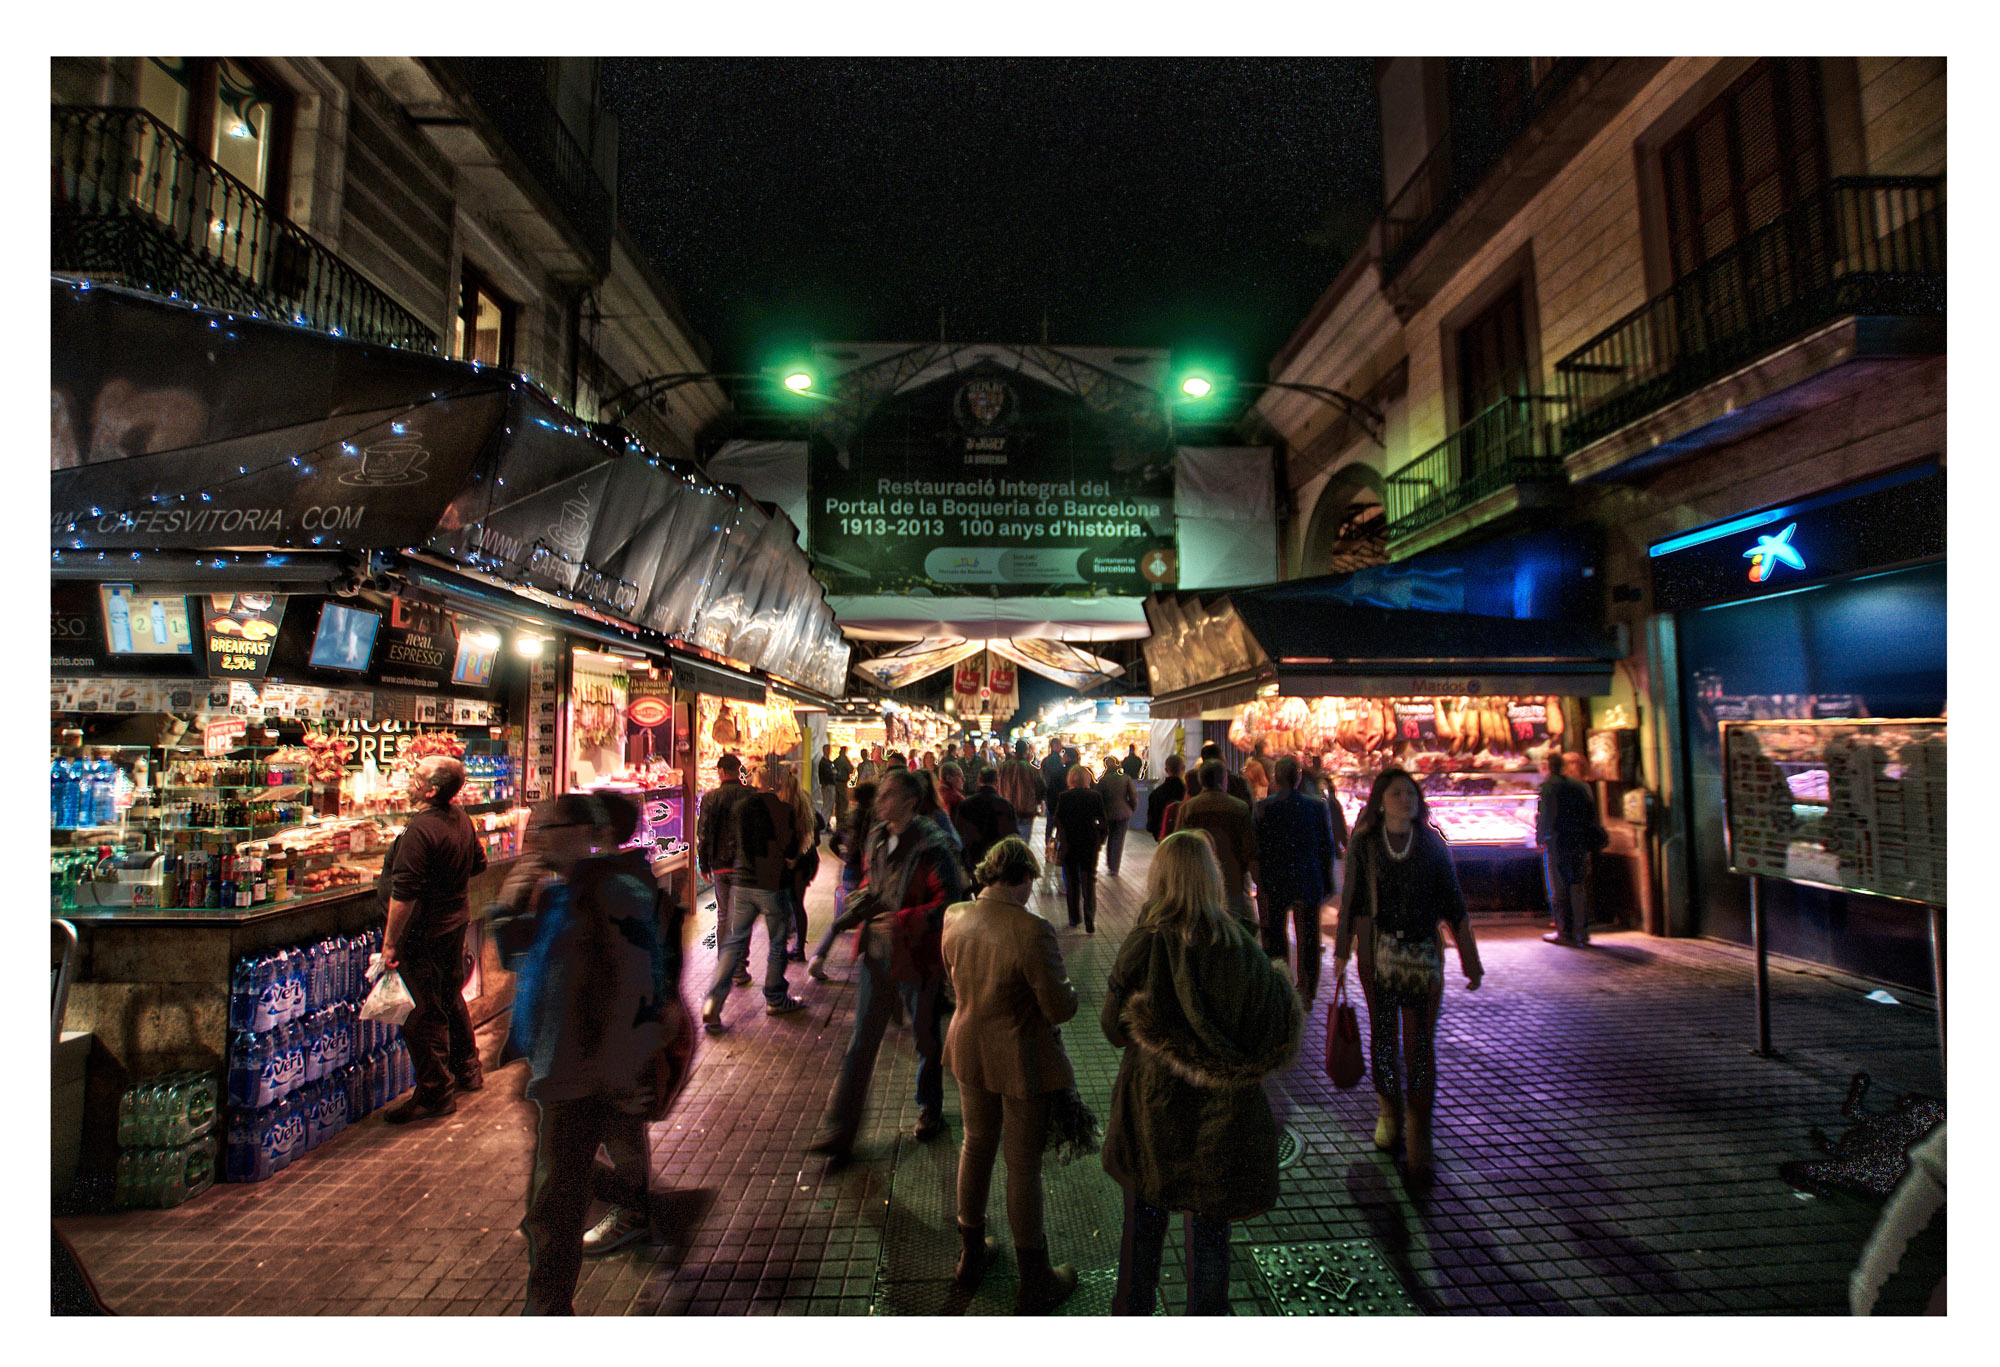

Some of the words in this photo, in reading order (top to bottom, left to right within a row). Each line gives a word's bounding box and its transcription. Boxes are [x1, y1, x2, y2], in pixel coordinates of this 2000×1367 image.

[878, 478, 995, 495] Restauració
[1000, 479, 1075, 500] Integral
[1081, 480, 1110, 496] del
[301, 504, 365, 530] COM
[826, 498, 885, 515] Portal
[890, 498, 914, 515] de
[920, 498, 937, 515] la
[943, 499, 1030, 519] Boqueria
[1035, 500, 1059, 516] de
[1064, 500, 1161, 517] Barcelona
[840, 519, 944, 536] 1913-2013
[960, 519, 994, 536] 100
[999, 520, 1045, 540] anys
[1093, 565, 1136, 573] Barcelona
[210, 636, 271, 656] BREAKFAST
[389, 644, 444, 667] ESPRESSO
[221, 655, 257, 671] 2,50€
[208, 734, 233, 754] OPE
[273, 979, 301, 1003] Veri
[321, 1028, 348, 1052] Veri
[273, 1050, 303, 1076] Veri
[319, 1091, 345, 1117] Veri
[273, 1117, 302, 1144] Veri
